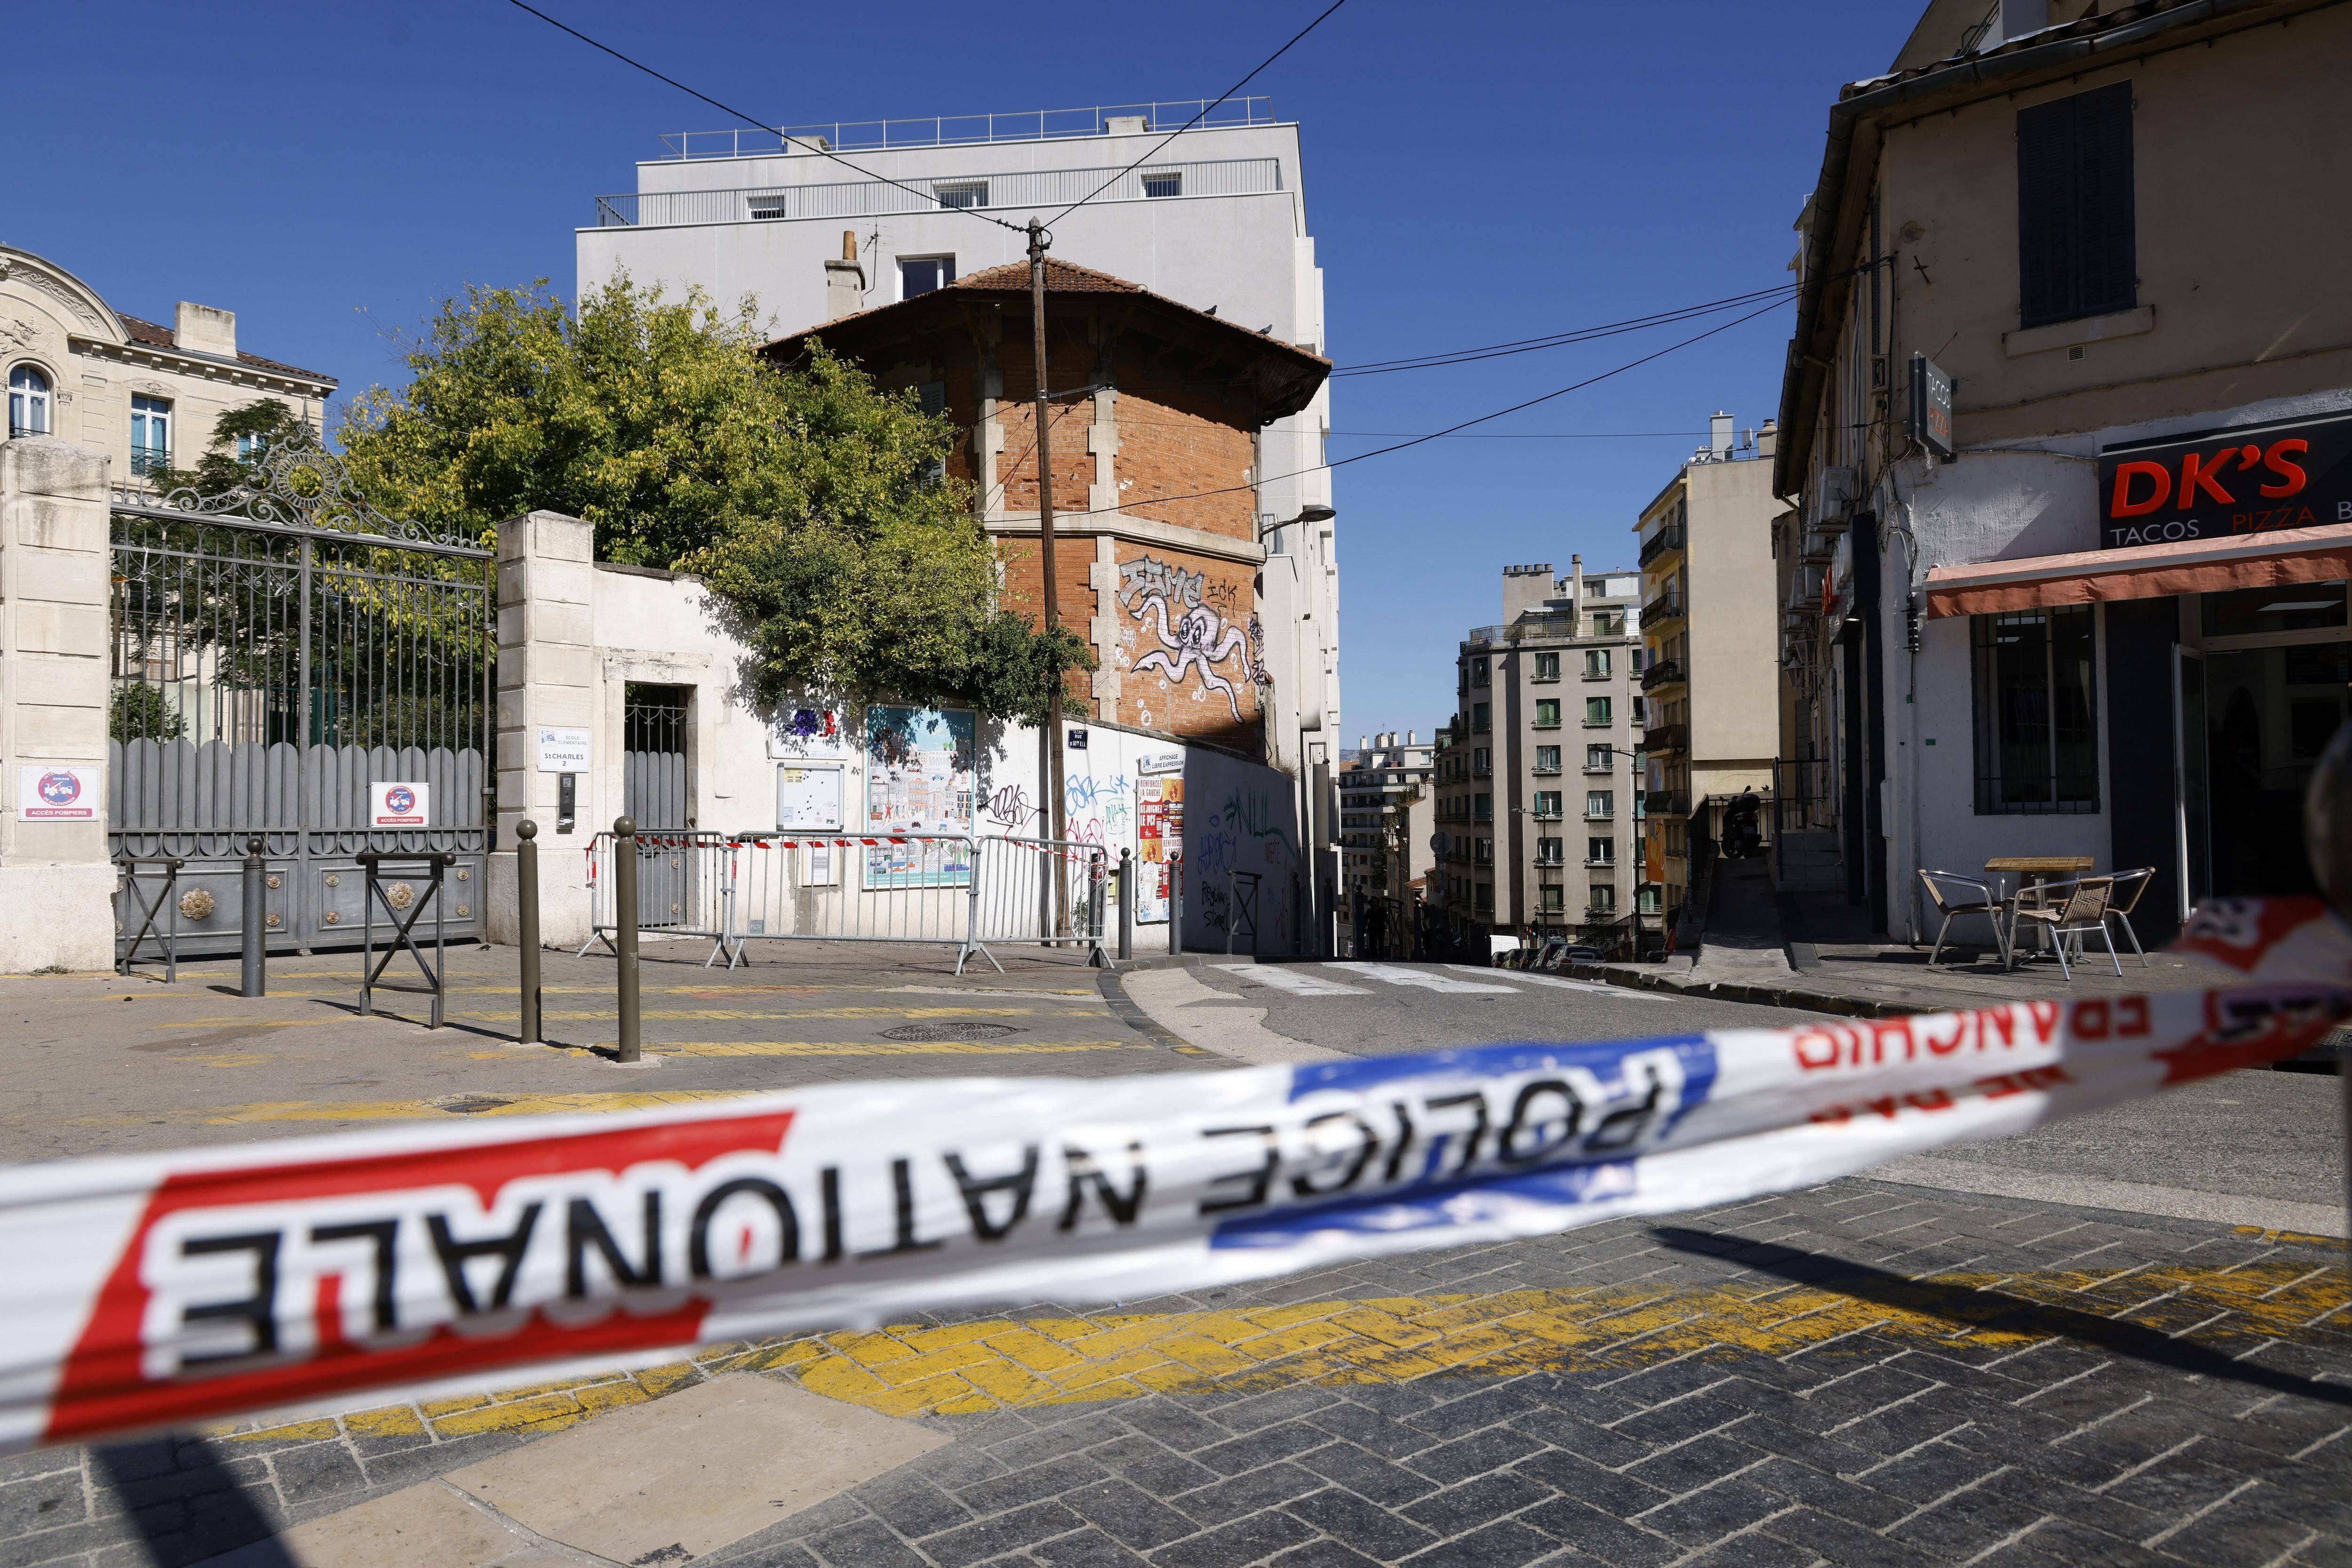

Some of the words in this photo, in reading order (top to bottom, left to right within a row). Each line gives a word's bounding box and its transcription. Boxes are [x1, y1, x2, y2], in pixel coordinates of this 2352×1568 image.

[1927, 372, 1950, 409] TACOS
[1929, 404, 1949, 439] PIZZA
[2110, 519, 2200, 546] TACOS
[2233, 505, 2317, 532] PIZZA
[1140, 804, 1162, 813] REJOIGNEZ
[1140, 815, 1145, 826] LE
[1147, 814, 1156, 826] PCF
[1199, 1062, 1666, 1216] POLICE
[176, 1138, 1149, 1373] NATIONALE
